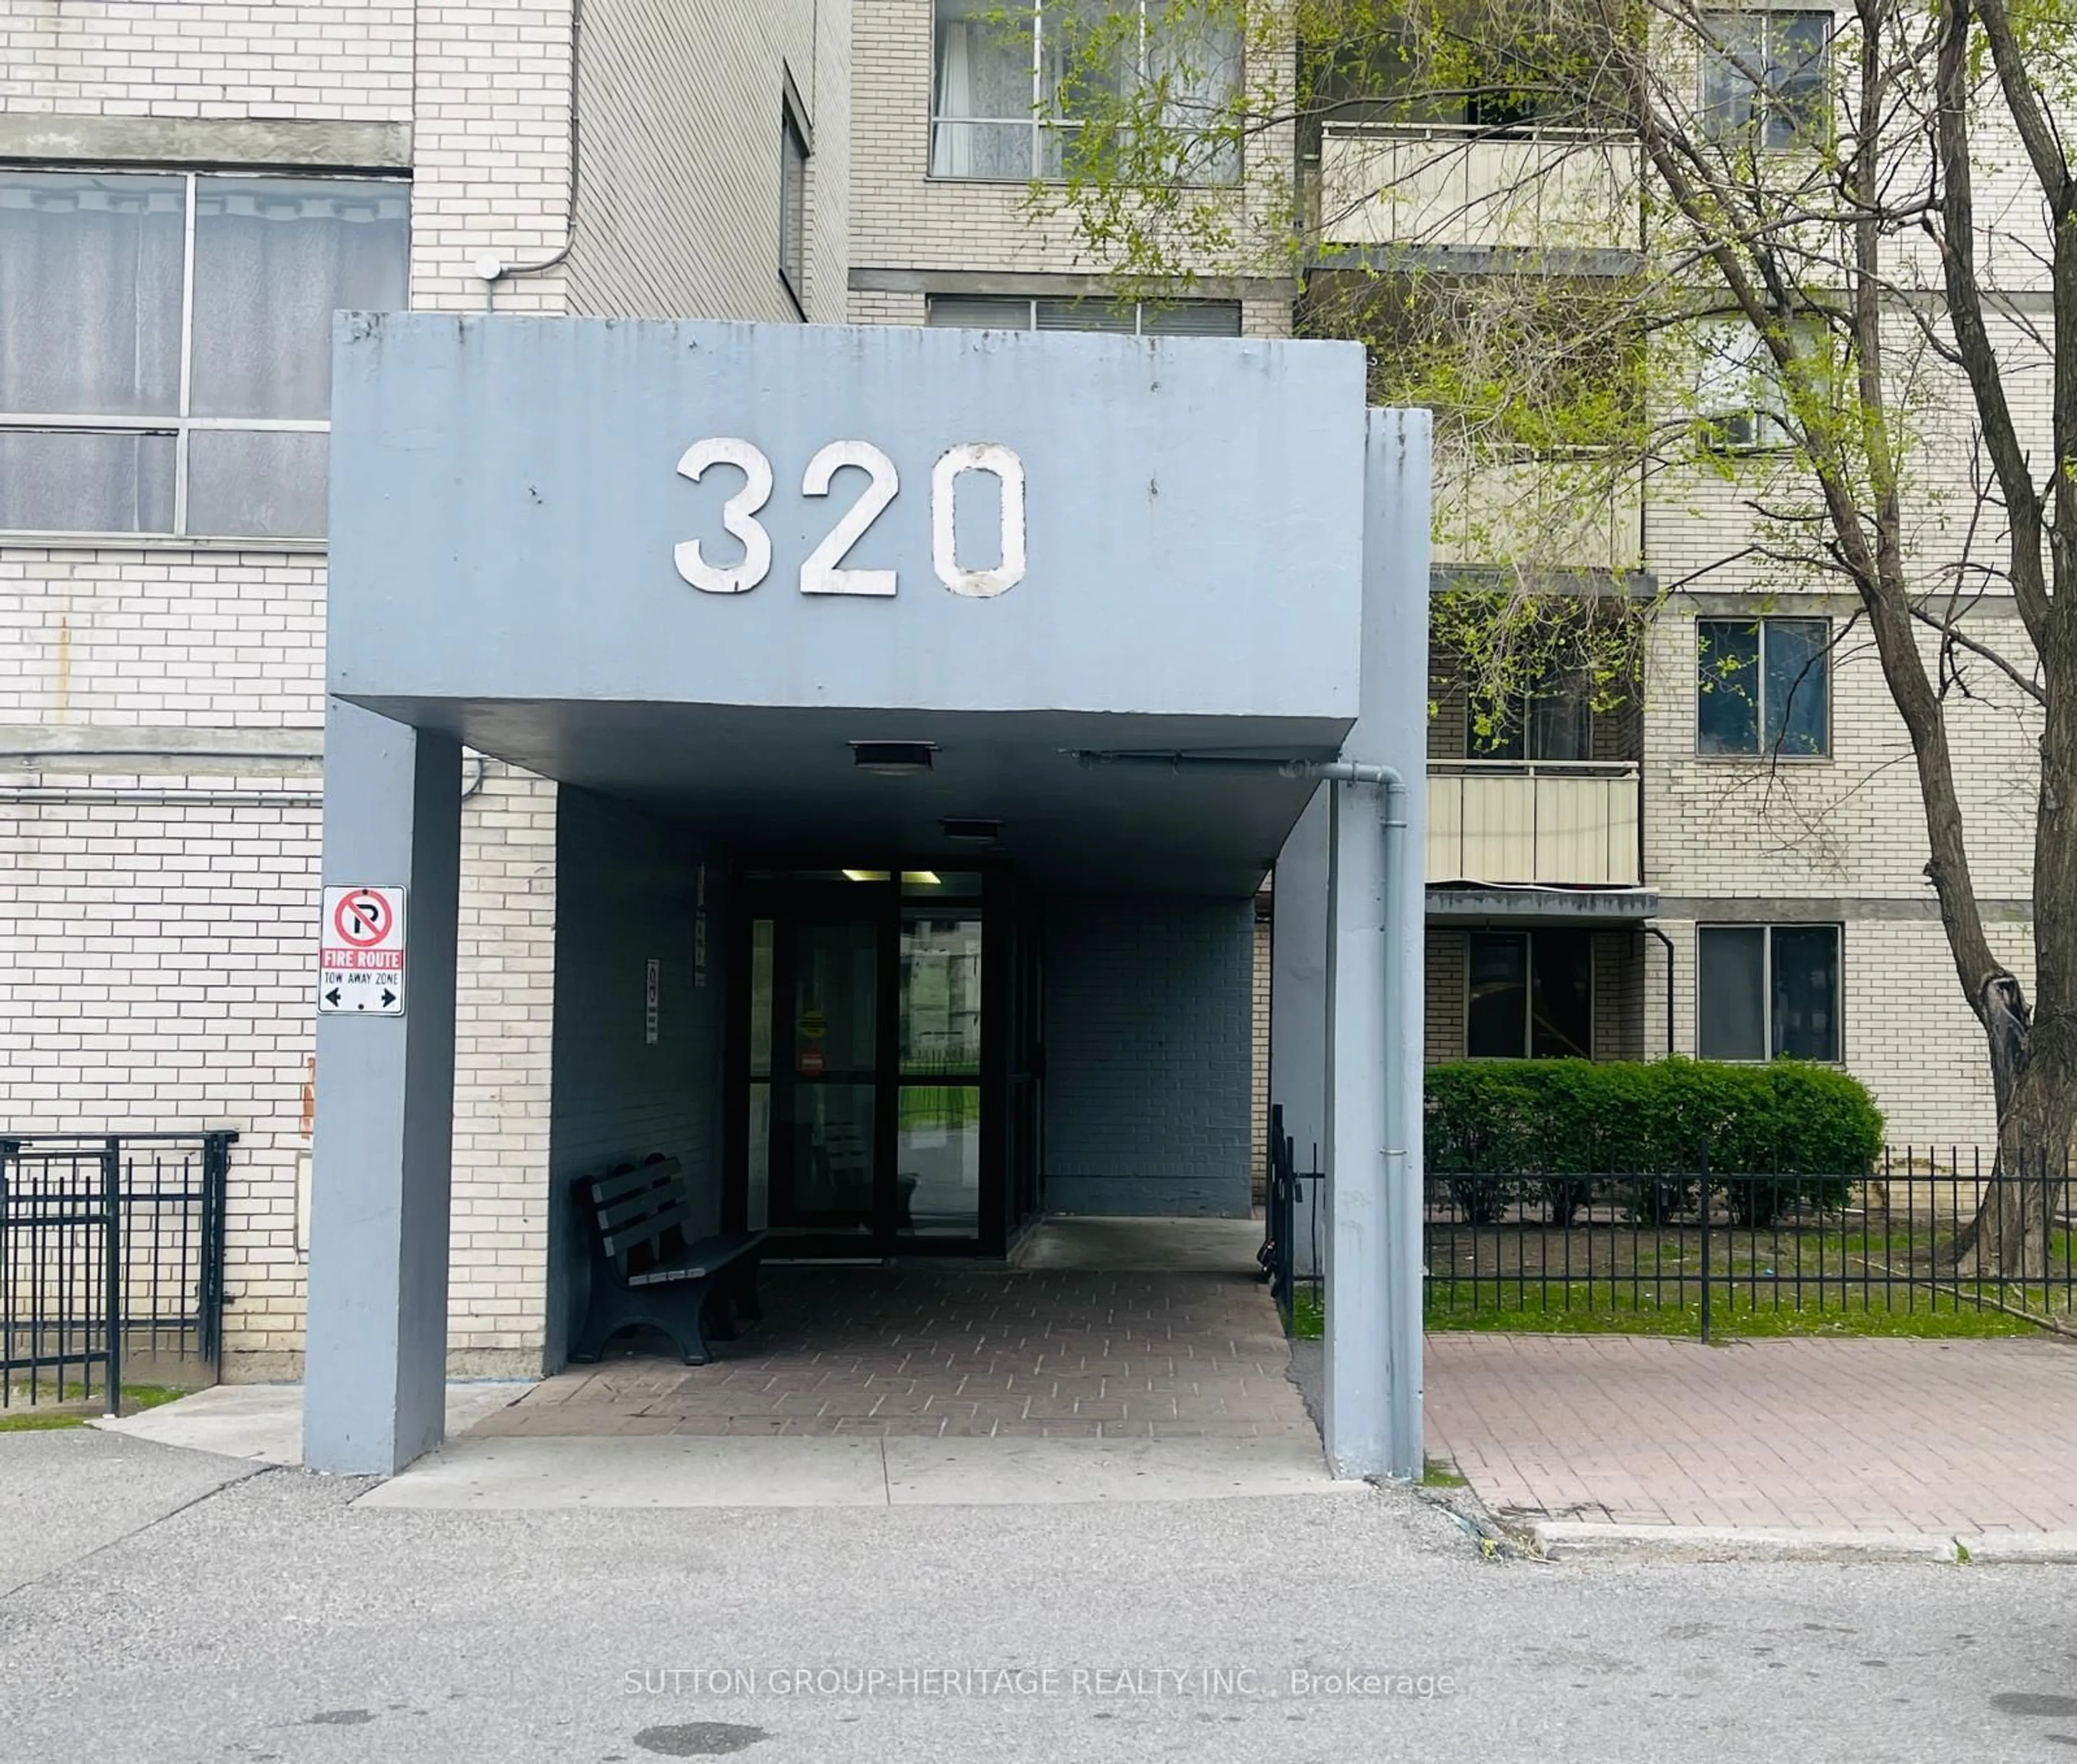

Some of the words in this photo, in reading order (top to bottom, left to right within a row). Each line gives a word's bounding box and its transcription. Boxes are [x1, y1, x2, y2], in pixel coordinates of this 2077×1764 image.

[673, 437, 1027, 597] 320
[325, 950, 354, 967] FIRE
[358, 951, 399, 968] ROUTE
[325, 972, 343, 984] TOW
[348, 972, 372, 985] AWAY
[375, 973, 399, 985] ZONE
